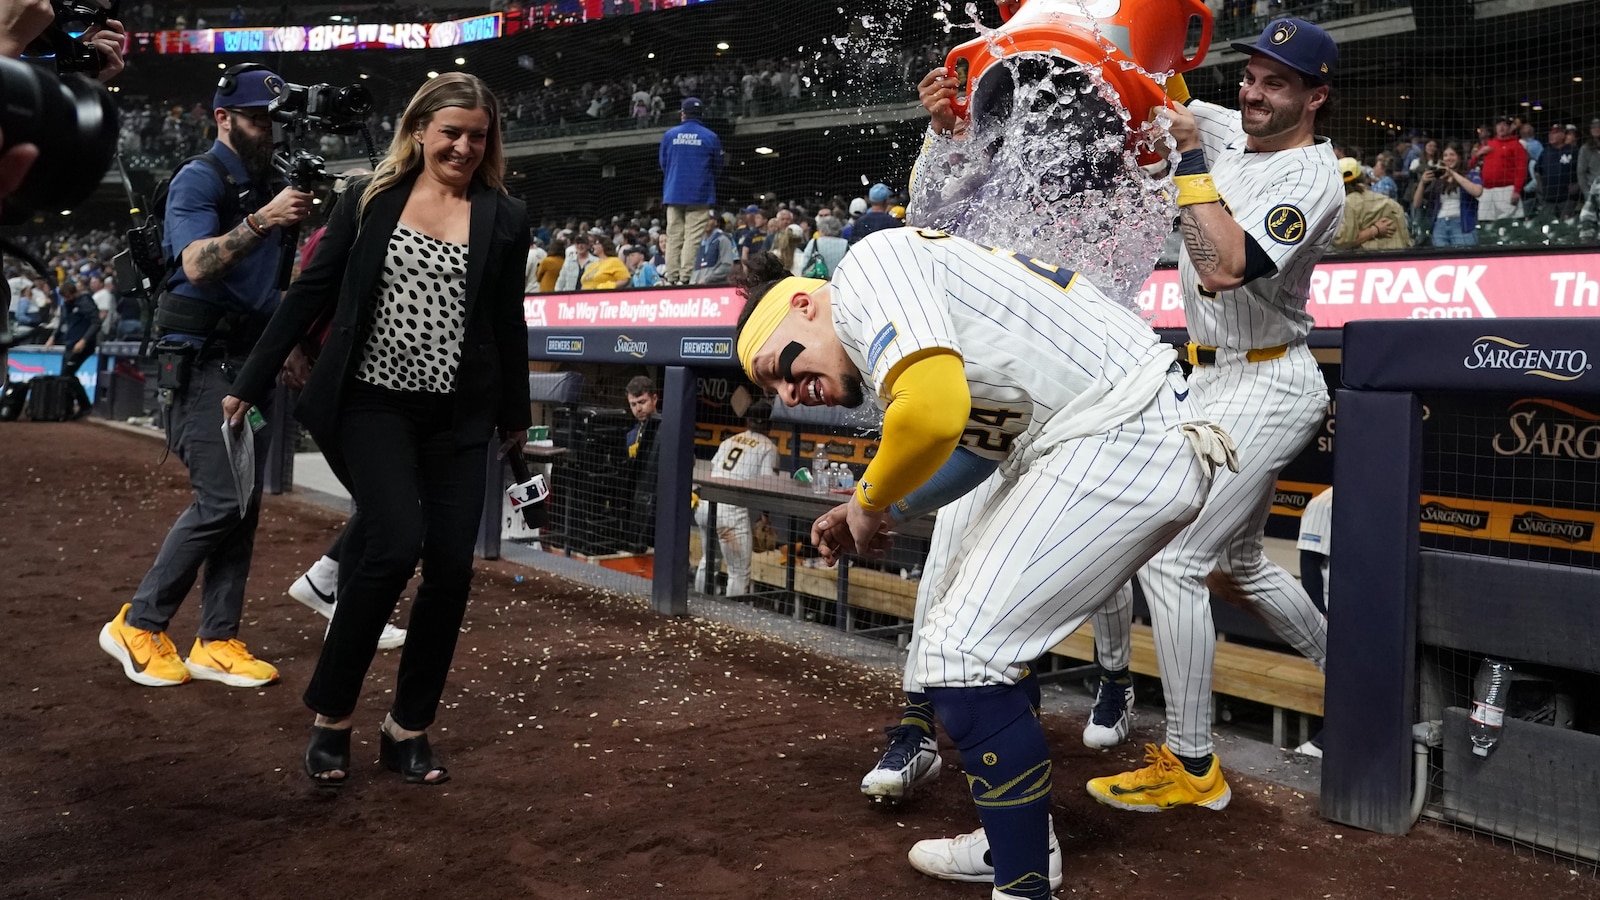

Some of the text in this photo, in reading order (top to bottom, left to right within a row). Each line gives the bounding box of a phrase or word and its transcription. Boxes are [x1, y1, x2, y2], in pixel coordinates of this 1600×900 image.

[223, 31, 264, 52] WIN
[308, 23, 427, 51] BREWERS
[463, 16, 496, 43] WIN
[1360, 265, 1497, 318] RACK
[557, 302, 575, 320] The
[575, 301, 599, 323] Way
[599, 300, 619, 319] Tire
[619, 299, 658, 323] Buying
[658, 298, 700, 318] Should
[548, 340, 582, 351] BREWERS.COM
[614, 338, 648, 353] SARGENTO
[683, 342, 730, 354] BREWERS.COM
[959, 407, 1024, 453] 24
[721, 446, 744, 473] 9
[1420, 506, 1481, 527] SARGENTO
[1517, 517, 1585, 539] SARGENTO
